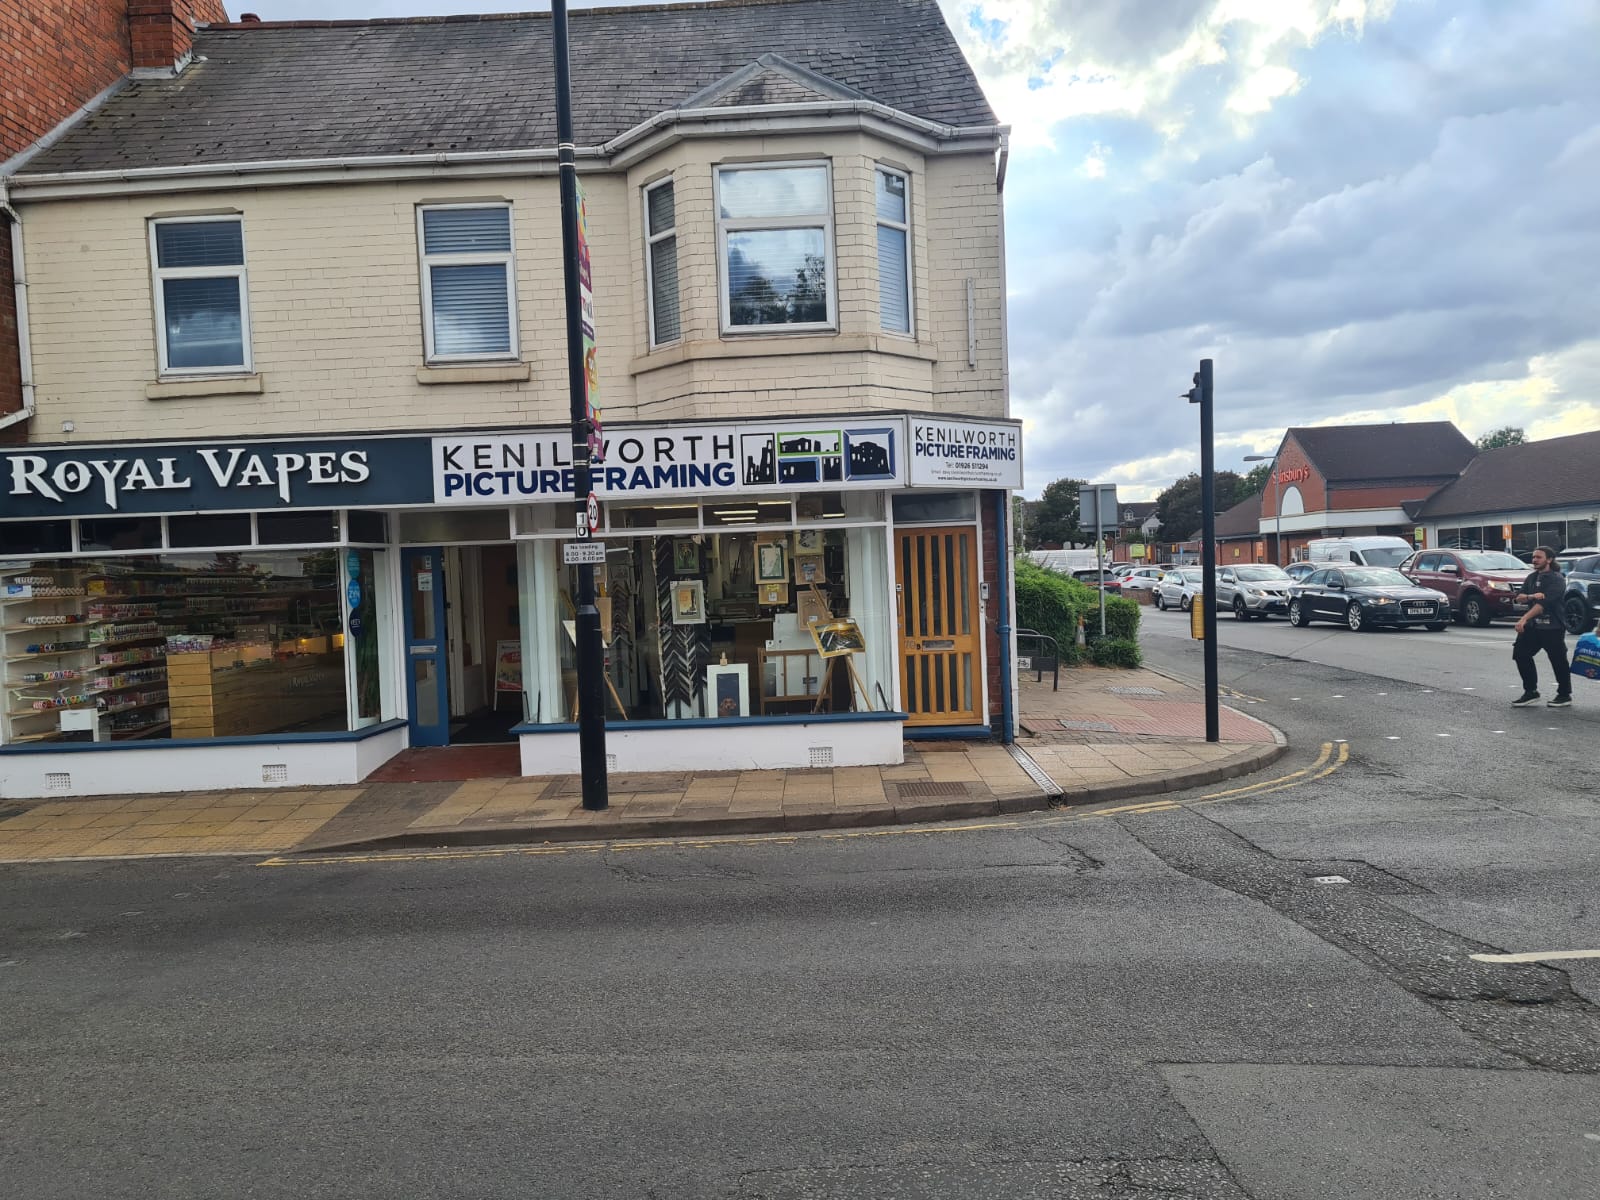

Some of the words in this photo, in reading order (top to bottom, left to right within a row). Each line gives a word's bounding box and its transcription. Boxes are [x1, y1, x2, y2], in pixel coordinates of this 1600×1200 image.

[914, 426, 1016, 447] KENILWORTH
[915, 442, 965, 459] PICTURE
[966, 445, 1016, 461] FRAMING
[954, 462, 970, 470] 01926
[971, 462, 989, 470] 511294
[6, 455, 191, 510] ROYAL
[196, 448, 370, 503] VAPES
[444, 469, 575, 497] PICTURE
[588, 462, 736, 491] FRAMING
[589, 504, 598, 520] 20
